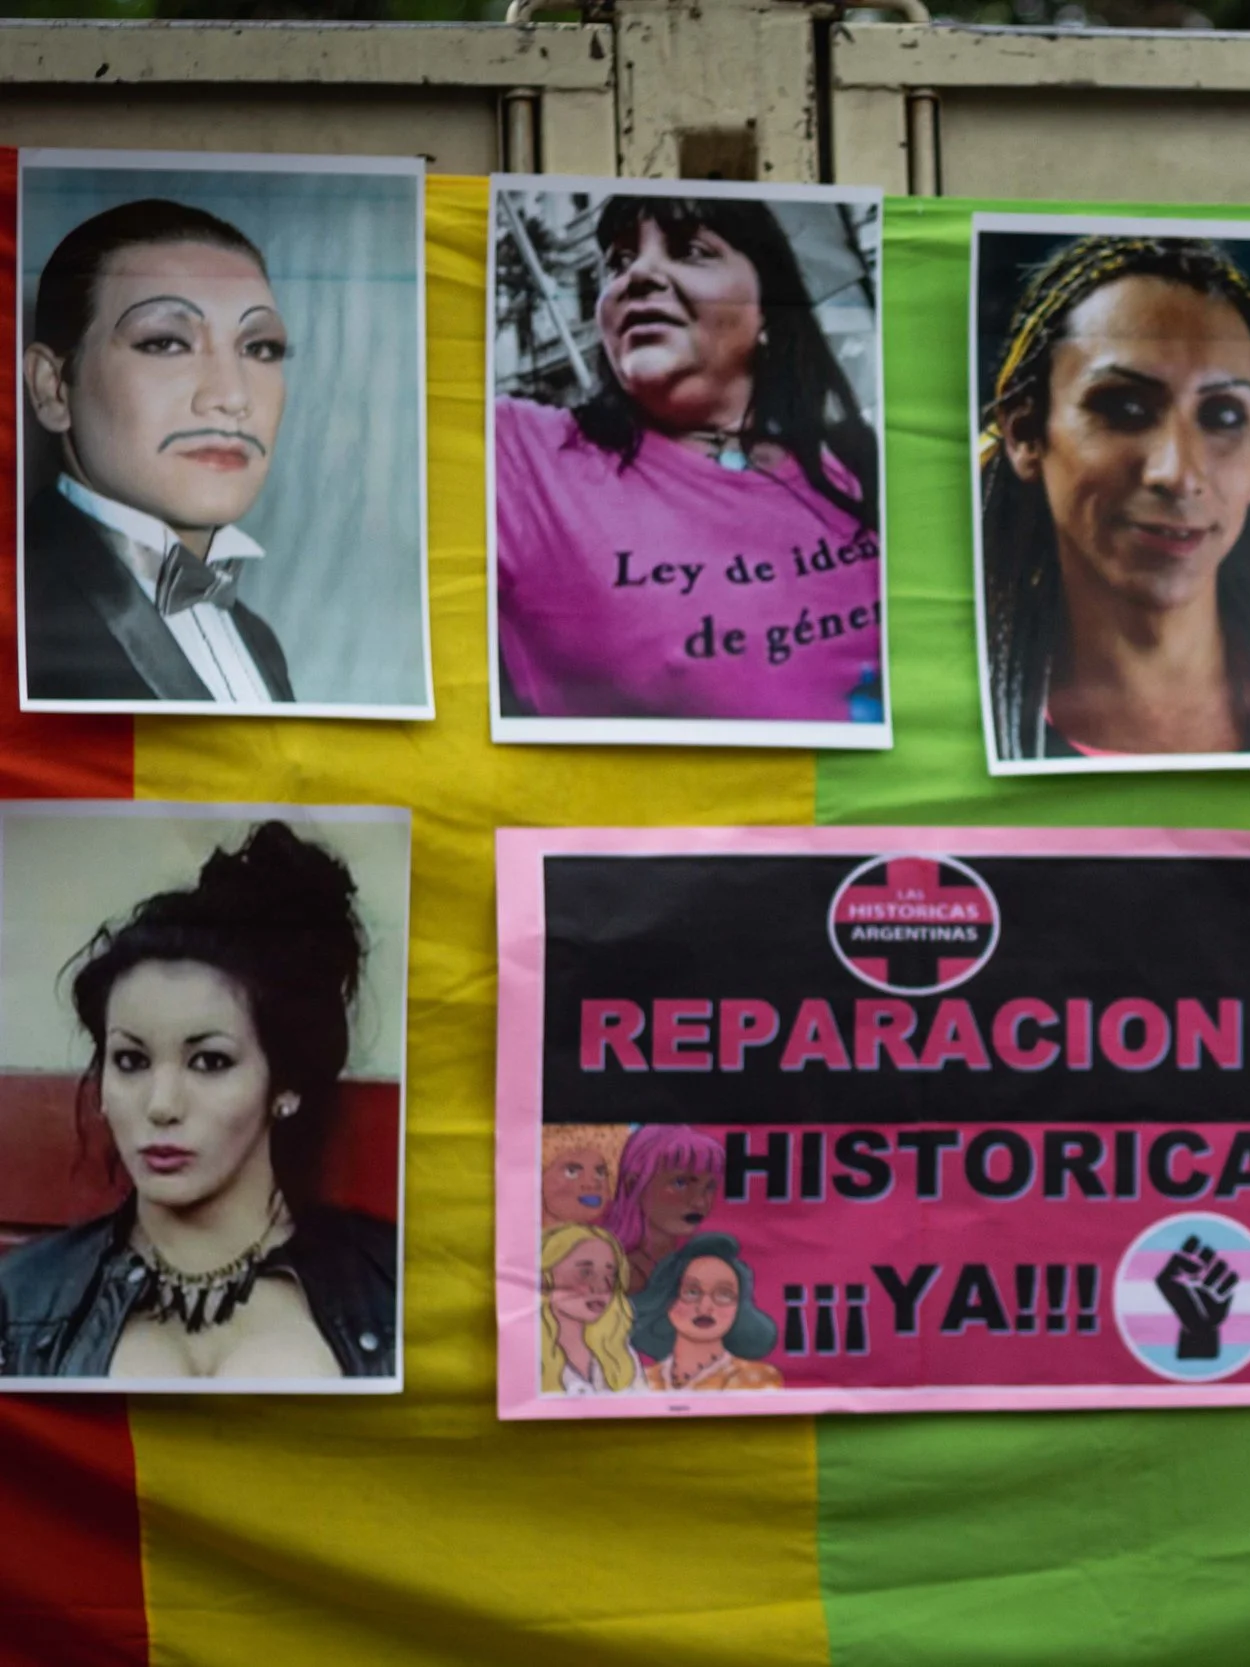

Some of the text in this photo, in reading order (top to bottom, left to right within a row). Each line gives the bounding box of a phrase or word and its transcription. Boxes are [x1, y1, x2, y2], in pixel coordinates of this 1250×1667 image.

[613, 551, 704, 594] Ley
[726, 555, 775, 583] de
[685, 616, 746, 658] de
[897, 888, 925, 901] LAS
[849, 903, 980, 919] HISTORICAS
[851, 926, 979, 941] ARGENTINAS
[579, 998, 1242, 1072] REPARACION
